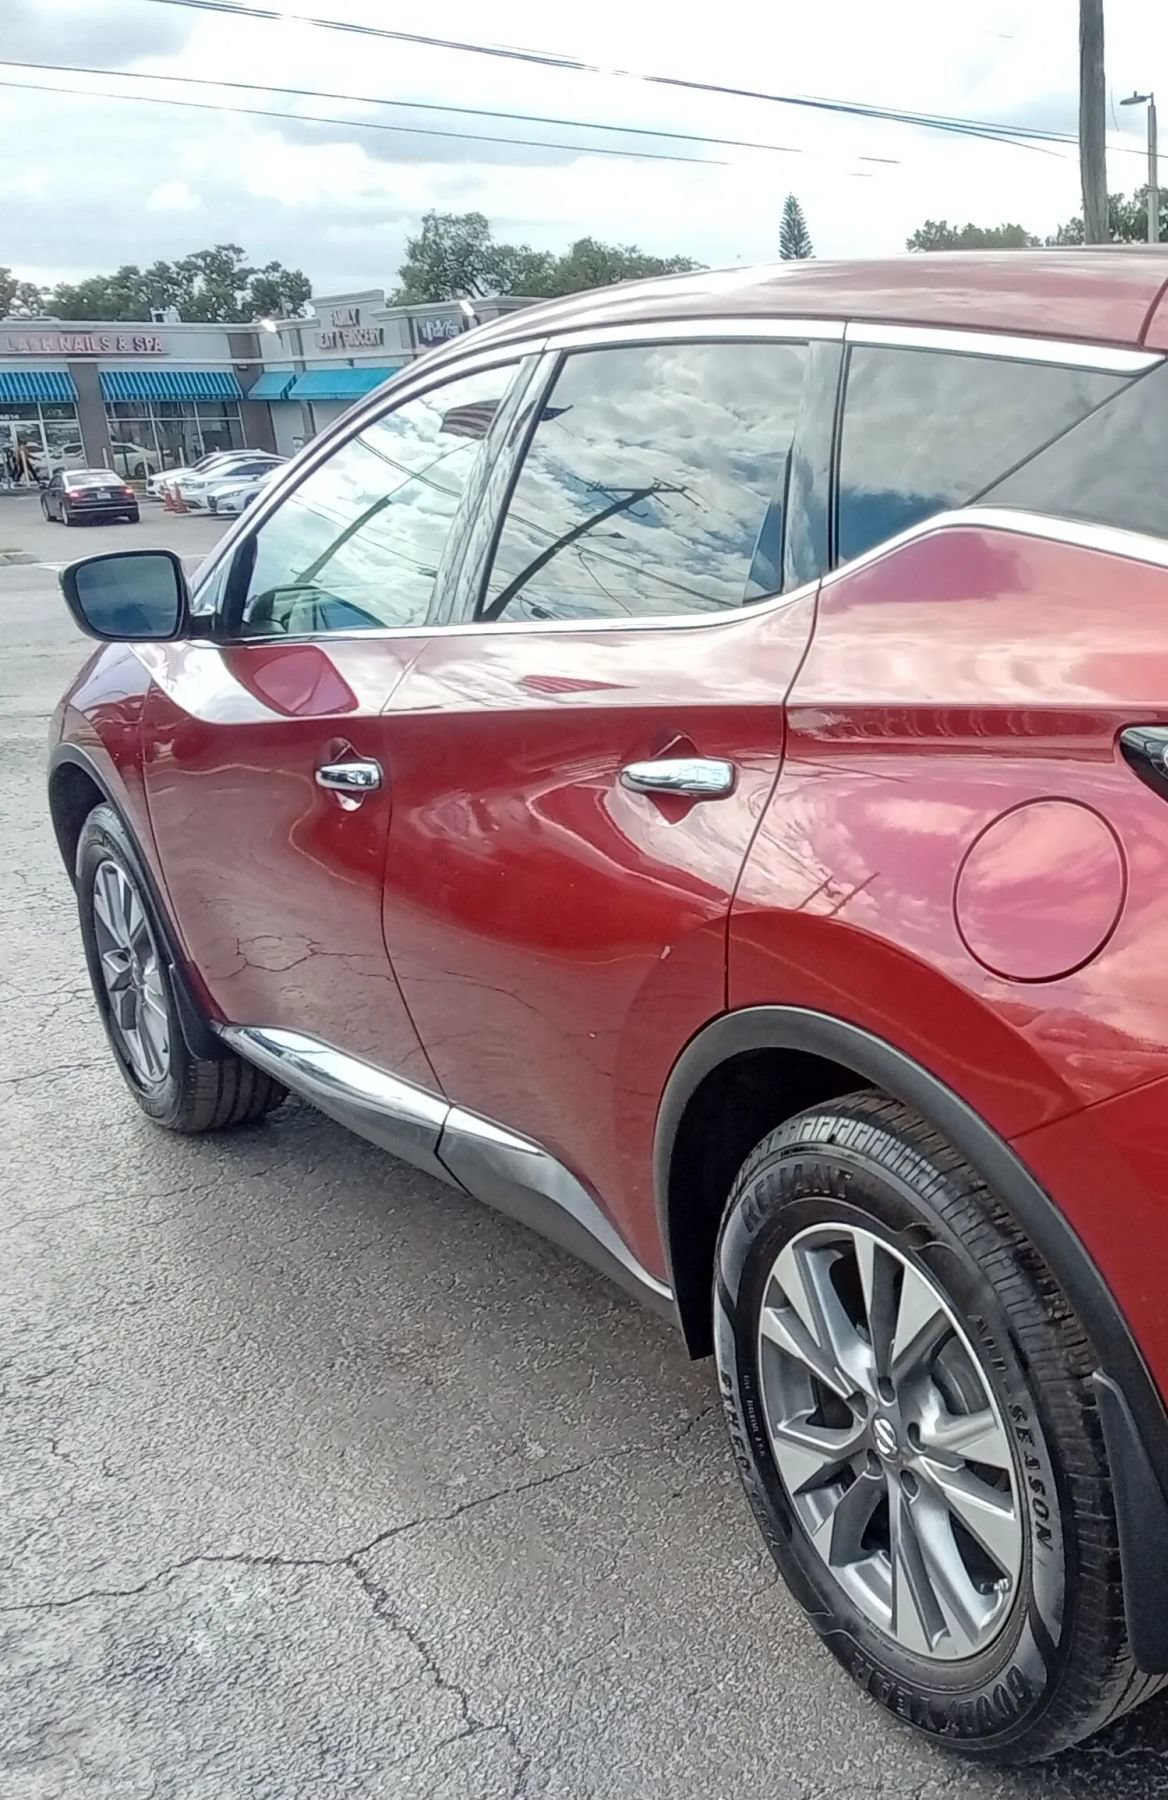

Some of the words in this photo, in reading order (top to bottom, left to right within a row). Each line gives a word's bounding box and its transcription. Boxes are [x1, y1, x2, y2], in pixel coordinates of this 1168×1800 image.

[58, 334, 110, 352] NAILS
[117, 336, 127, 350] &
[132, 336, 163, 352] SPA
[740, 1161, 853, 1235] RELIANT
